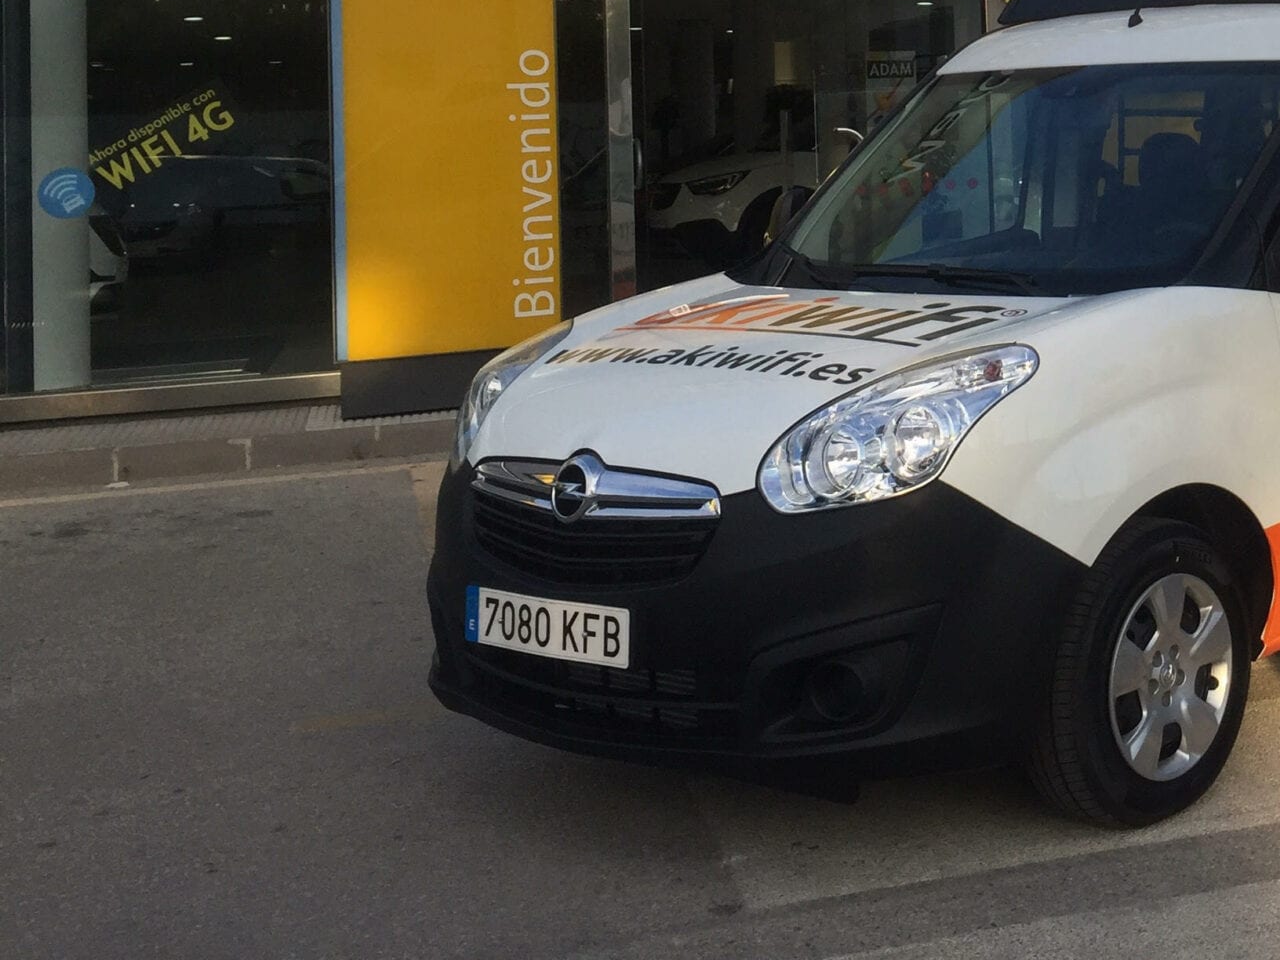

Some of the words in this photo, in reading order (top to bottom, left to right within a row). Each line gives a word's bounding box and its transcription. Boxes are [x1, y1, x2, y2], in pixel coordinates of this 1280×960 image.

[868, 62, 913, 77] ADAM
[88, 138, 128, 166] Ahora
[127, 102, 193, 143] disponible
[192, 88, 217, 107] con
[95, 129, 183, 190] WIFI
[187, 100, 235, 144] 4G
[506, 48, 556, 319] Bienvenido
[544, 345, 877, 385] www.akiwifi.es
[484, 597, 551, 648] 7080
[561, 609, 621, 658] KFB
